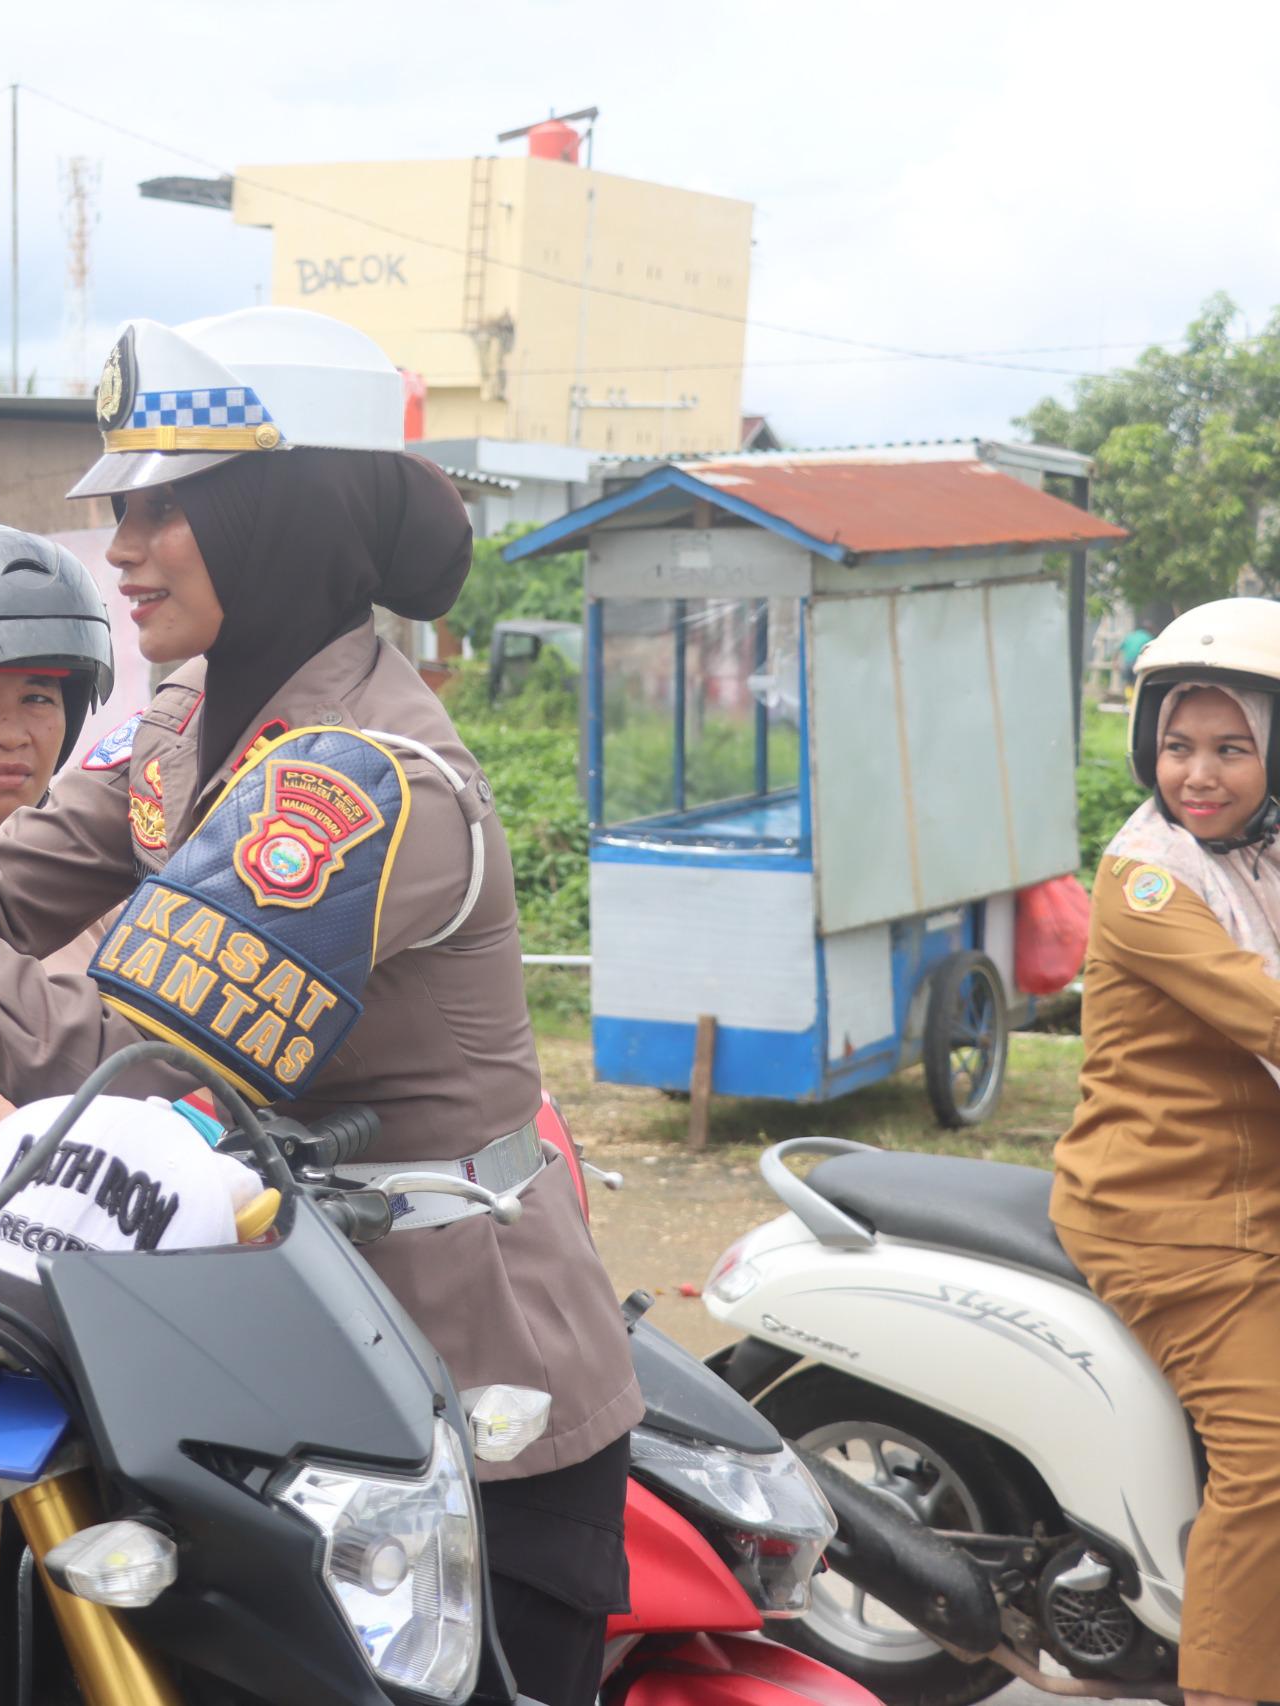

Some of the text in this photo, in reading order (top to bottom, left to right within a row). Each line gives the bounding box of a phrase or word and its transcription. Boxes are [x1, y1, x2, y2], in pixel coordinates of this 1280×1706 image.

[294, 254, 408, 296] BACOK
[281, 799, 343, 837] MALUKU UTARA
[285, 771, 365, 819] POLRES
[135, 887, 339, 1032] KASAT
[98, 925, 315, 1083] LANTAS
